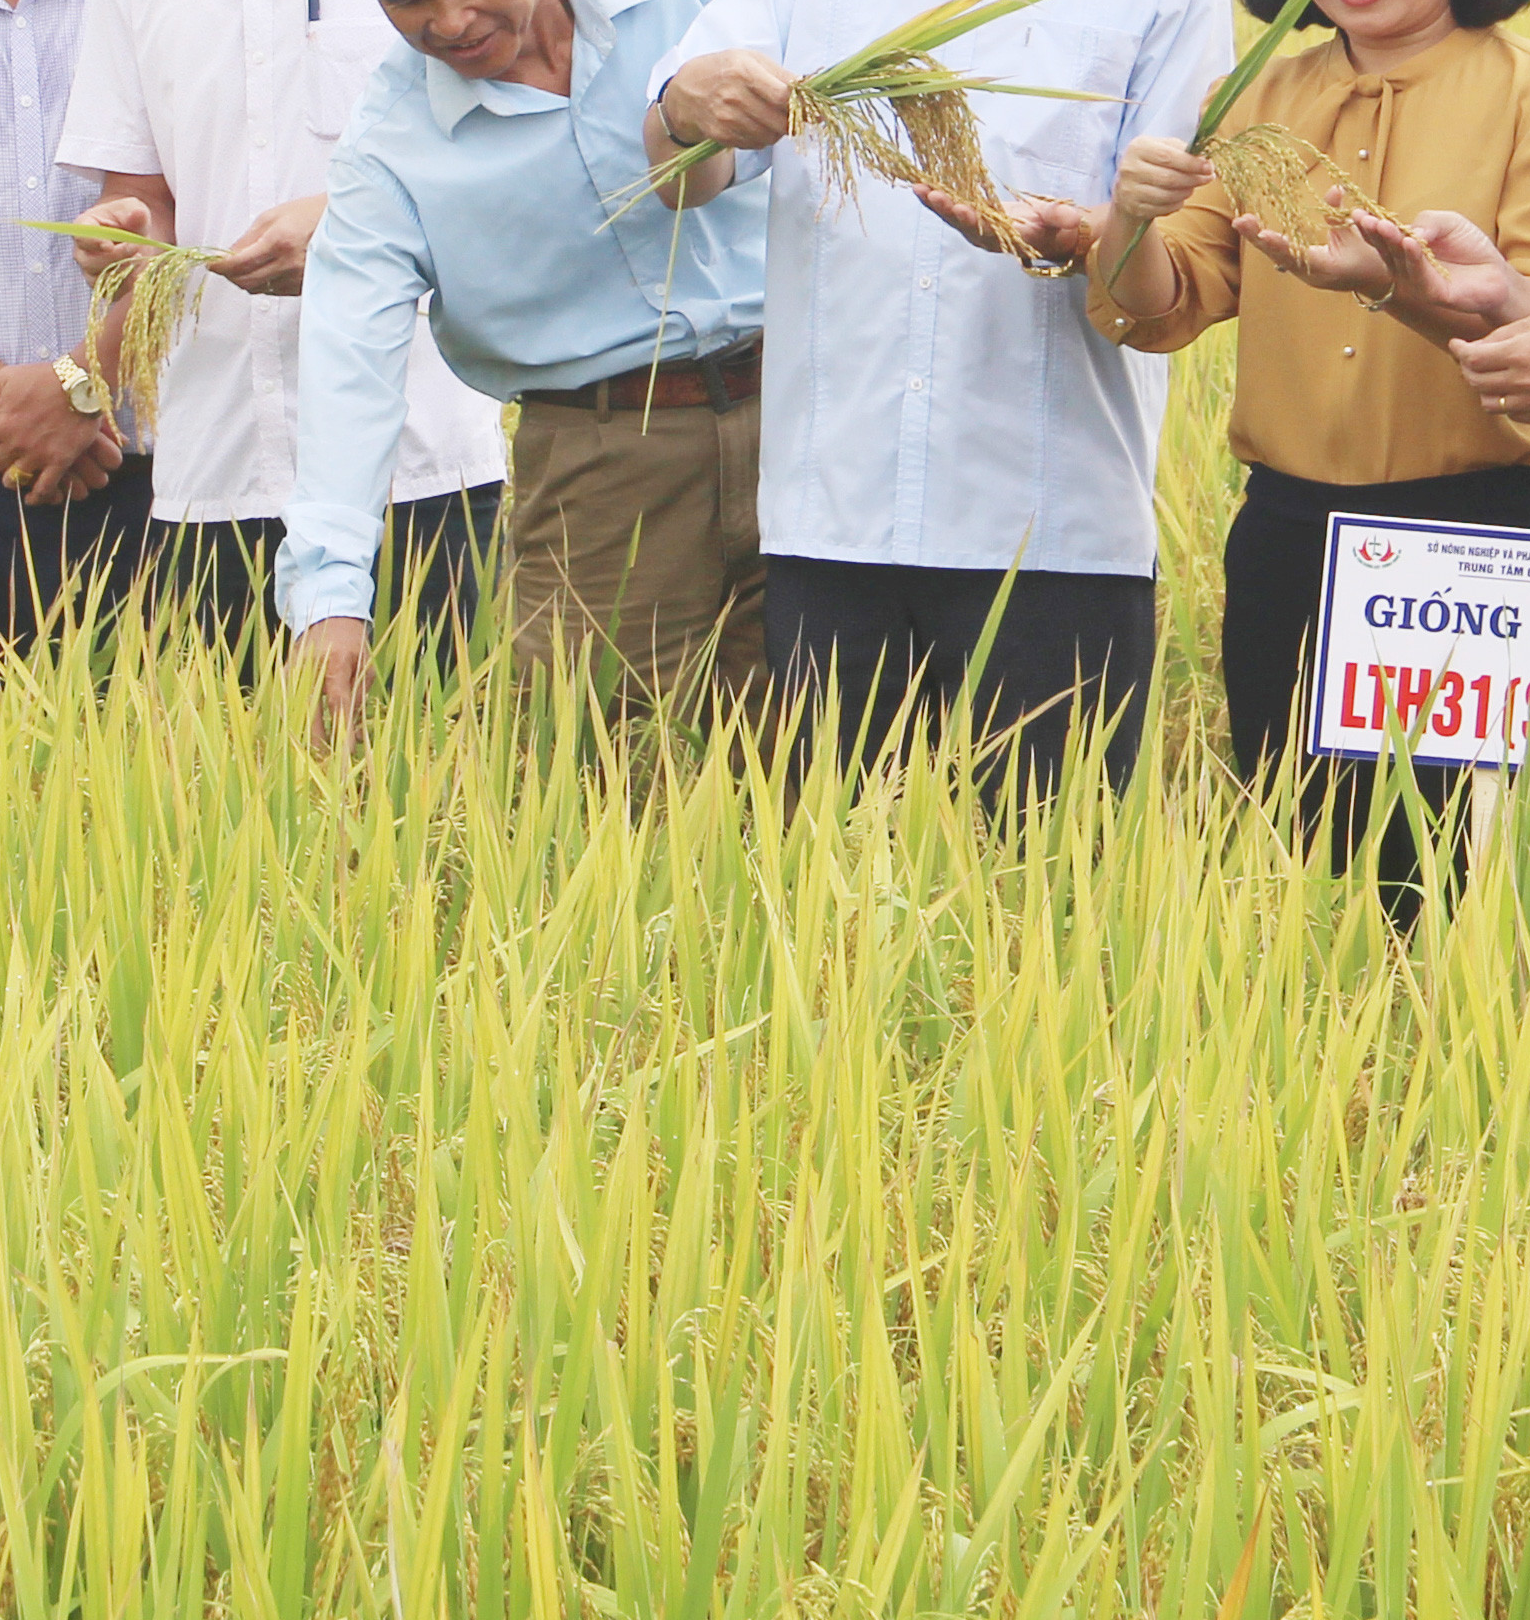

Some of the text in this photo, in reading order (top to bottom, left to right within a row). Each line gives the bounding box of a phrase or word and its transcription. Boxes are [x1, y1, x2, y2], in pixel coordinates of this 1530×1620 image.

[1442, 543, 1465, 556] NÔNG
[1468, 545, 1500, 559] NGHIỆP
[1503, 547, 1514, 559] VÀ
[1458, 562, 1494, 574] TRUNG
[1500, 565, 1524, 576] TÂM
[1365, 587, 1522, 639] GIỐNG
